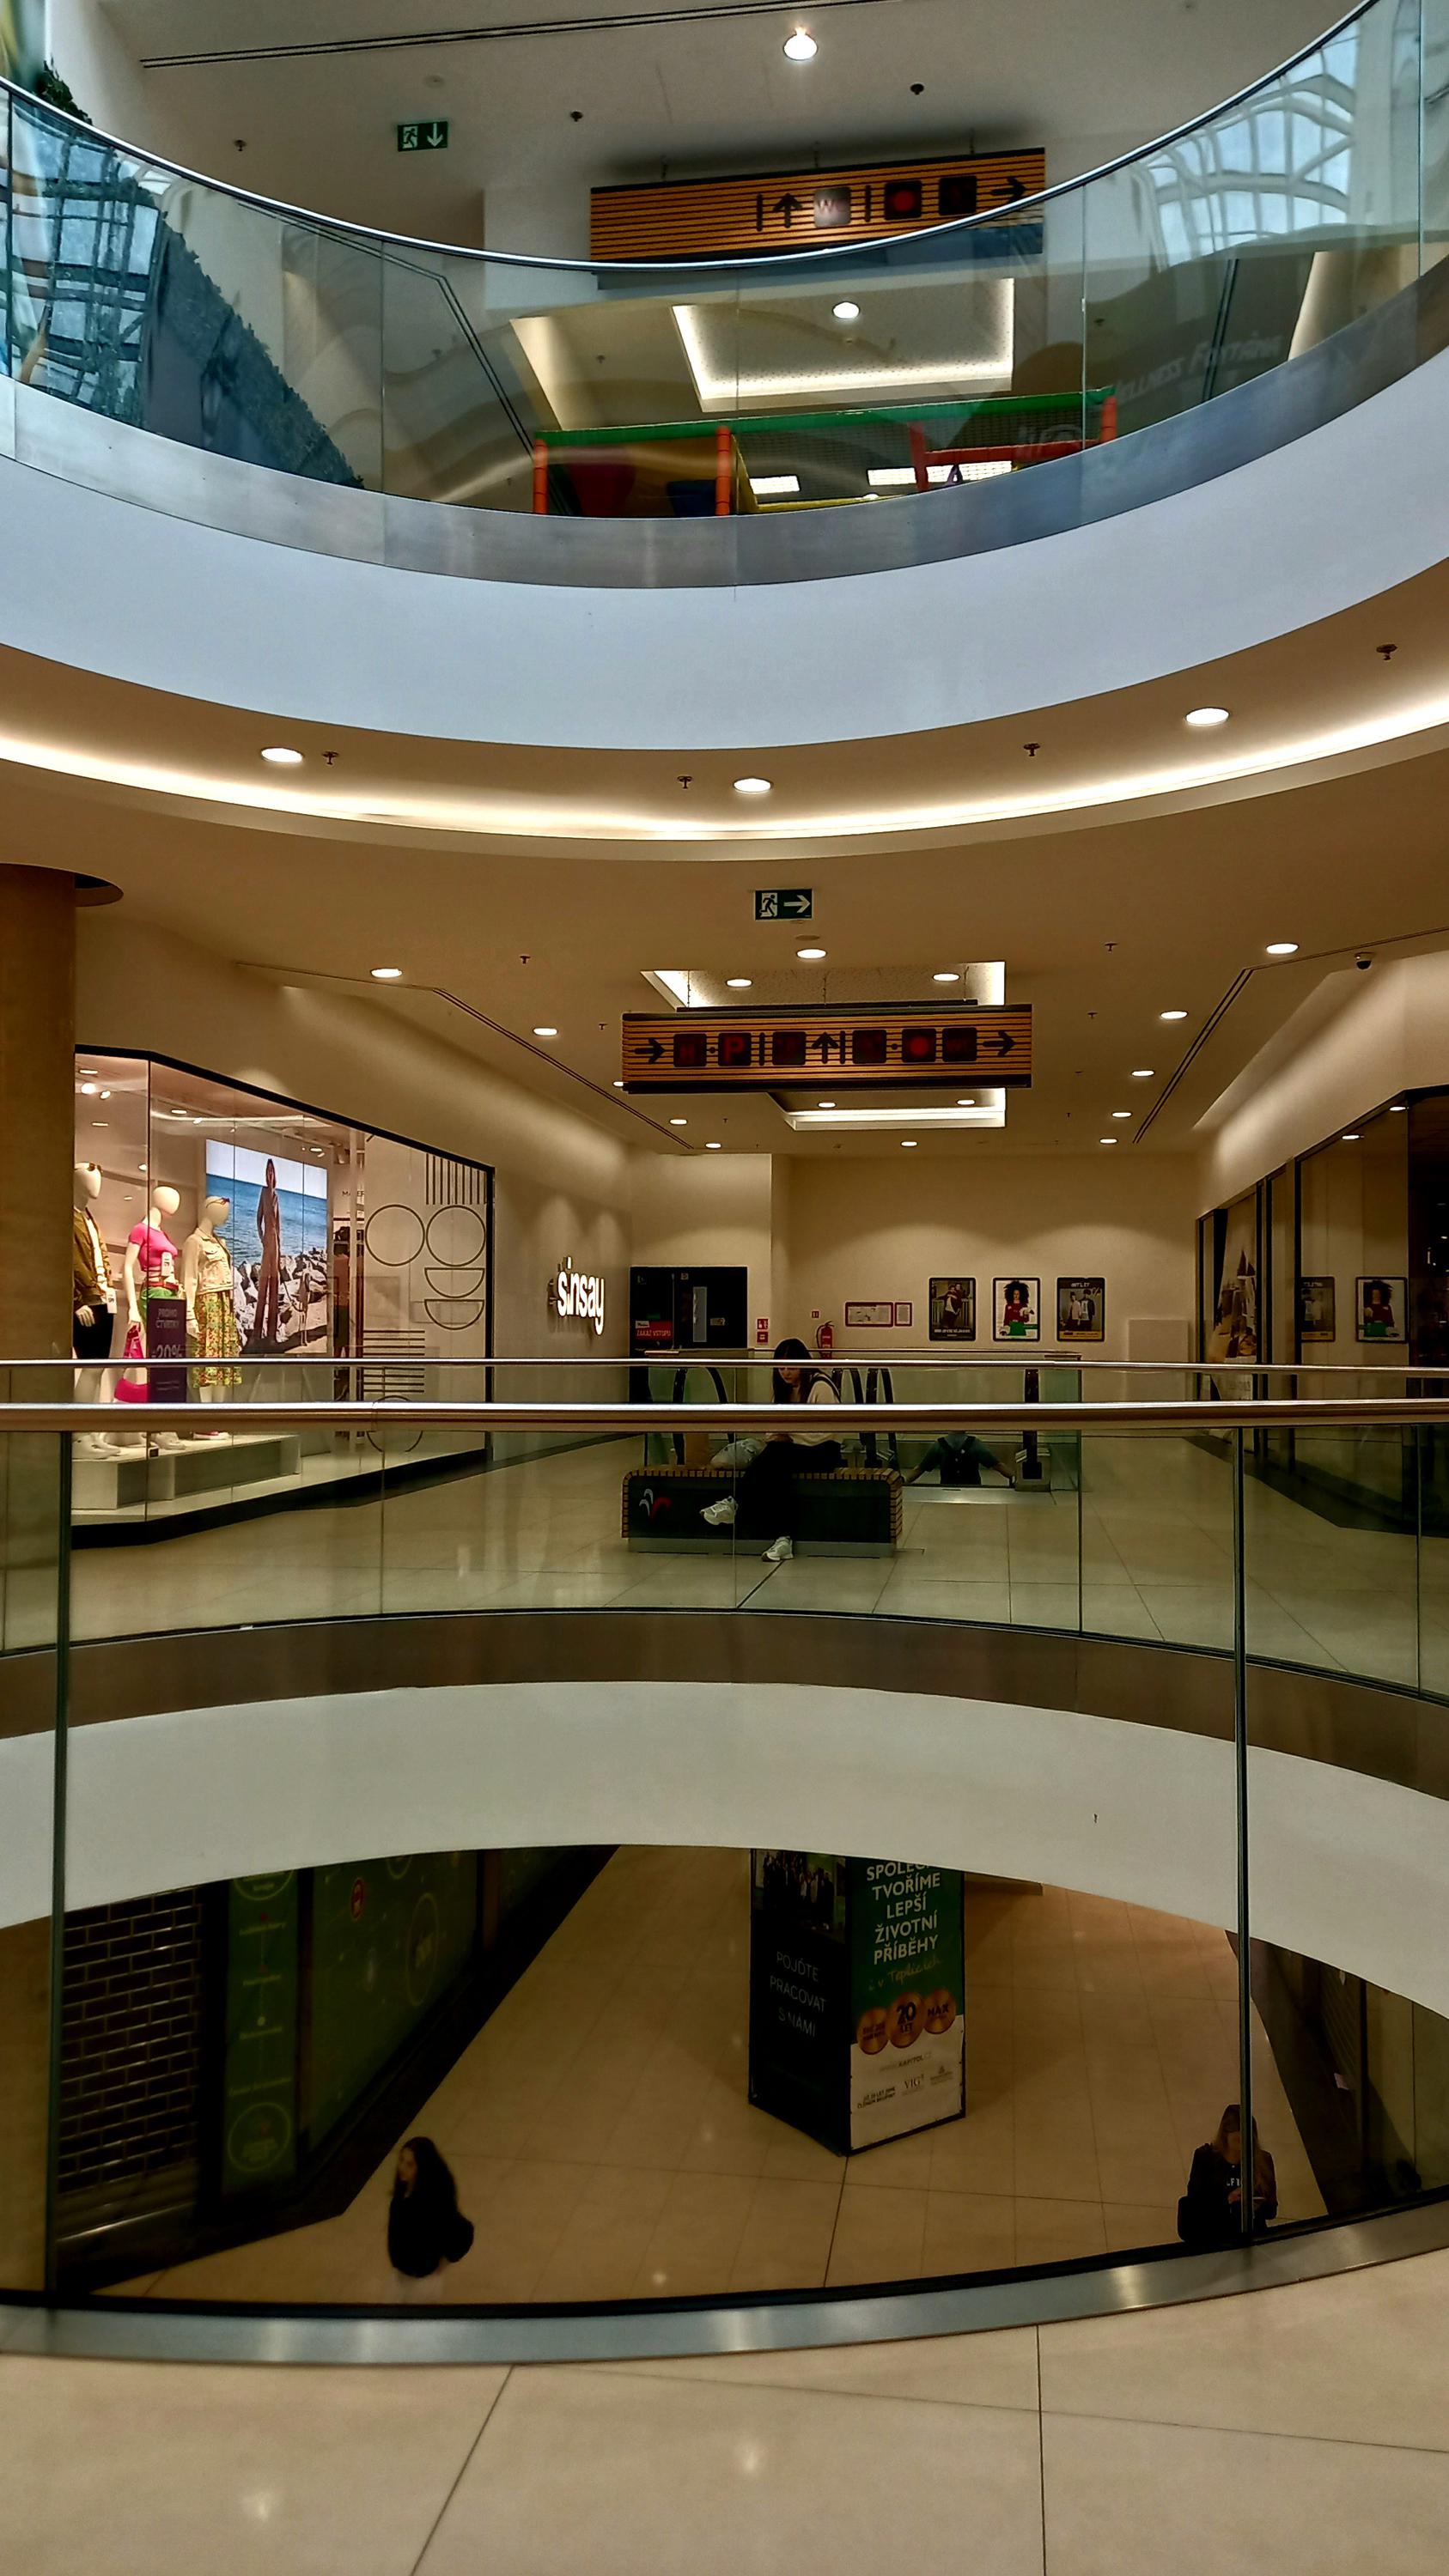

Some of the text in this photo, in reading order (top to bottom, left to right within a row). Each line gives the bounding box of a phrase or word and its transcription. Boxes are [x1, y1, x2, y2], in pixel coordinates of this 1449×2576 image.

[557, 1255, 605, 1335] sinsay
[872, 1872, 941, 1901] TVOŘÍME
[886, 1891, 928, 1920] LEPŠÍ
[874, 1909, 938, 1944] ŽIVOTNÍ
[874, 1934, 939, 1965] PŘÍBĚHY
[776, 1950, 819, 1982] POJĎTE
[770, 1976, 828, 2013] PRACOVAT
[927, 2003, 949, 2016] MAX
[896, 2002, 916, 2025] 20
[899, 2022, 913, 2034] LET
